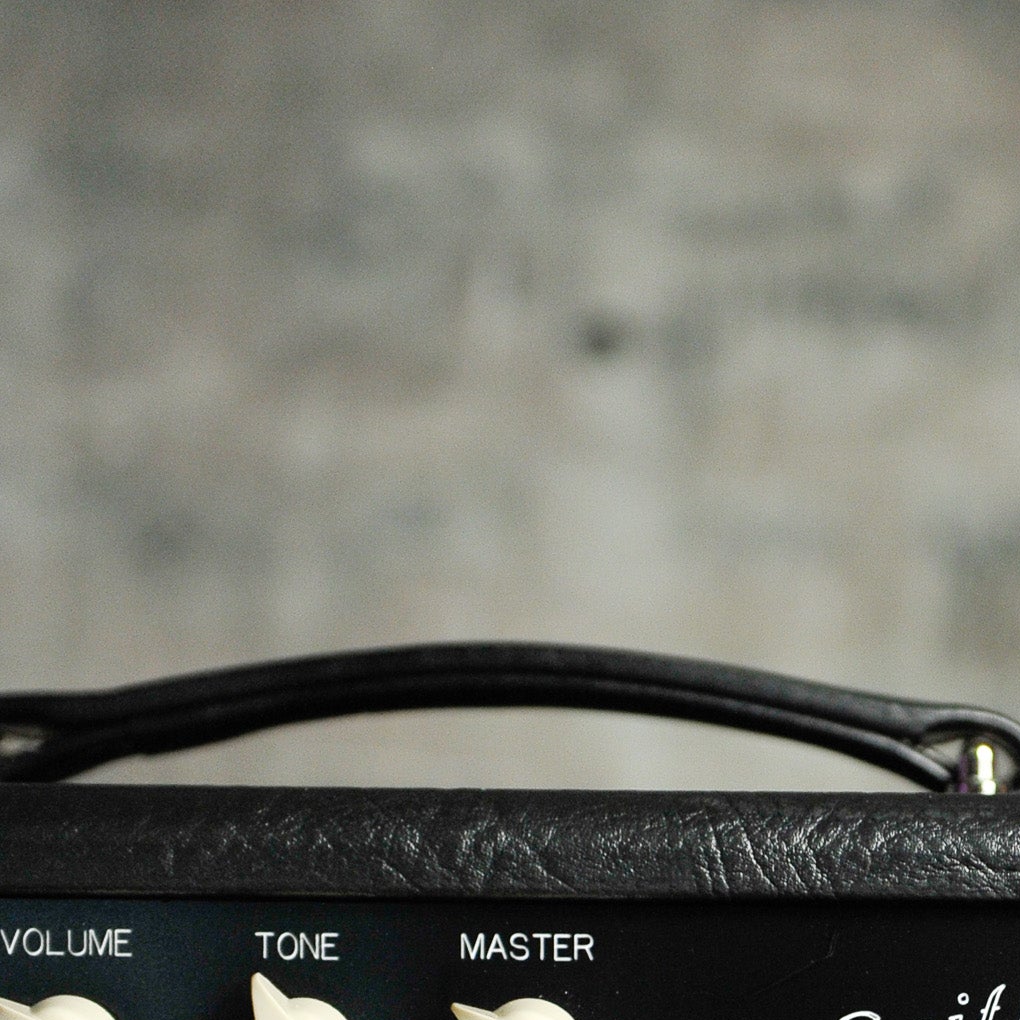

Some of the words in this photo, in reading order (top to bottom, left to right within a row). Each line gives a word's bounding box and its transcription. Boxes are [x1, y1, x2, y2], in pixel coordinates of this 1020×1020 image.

[0, 927, 133, 957] VOLUME
[254, 931, 340, 961] TONE
[460, 932, 595, 962] MASTER
